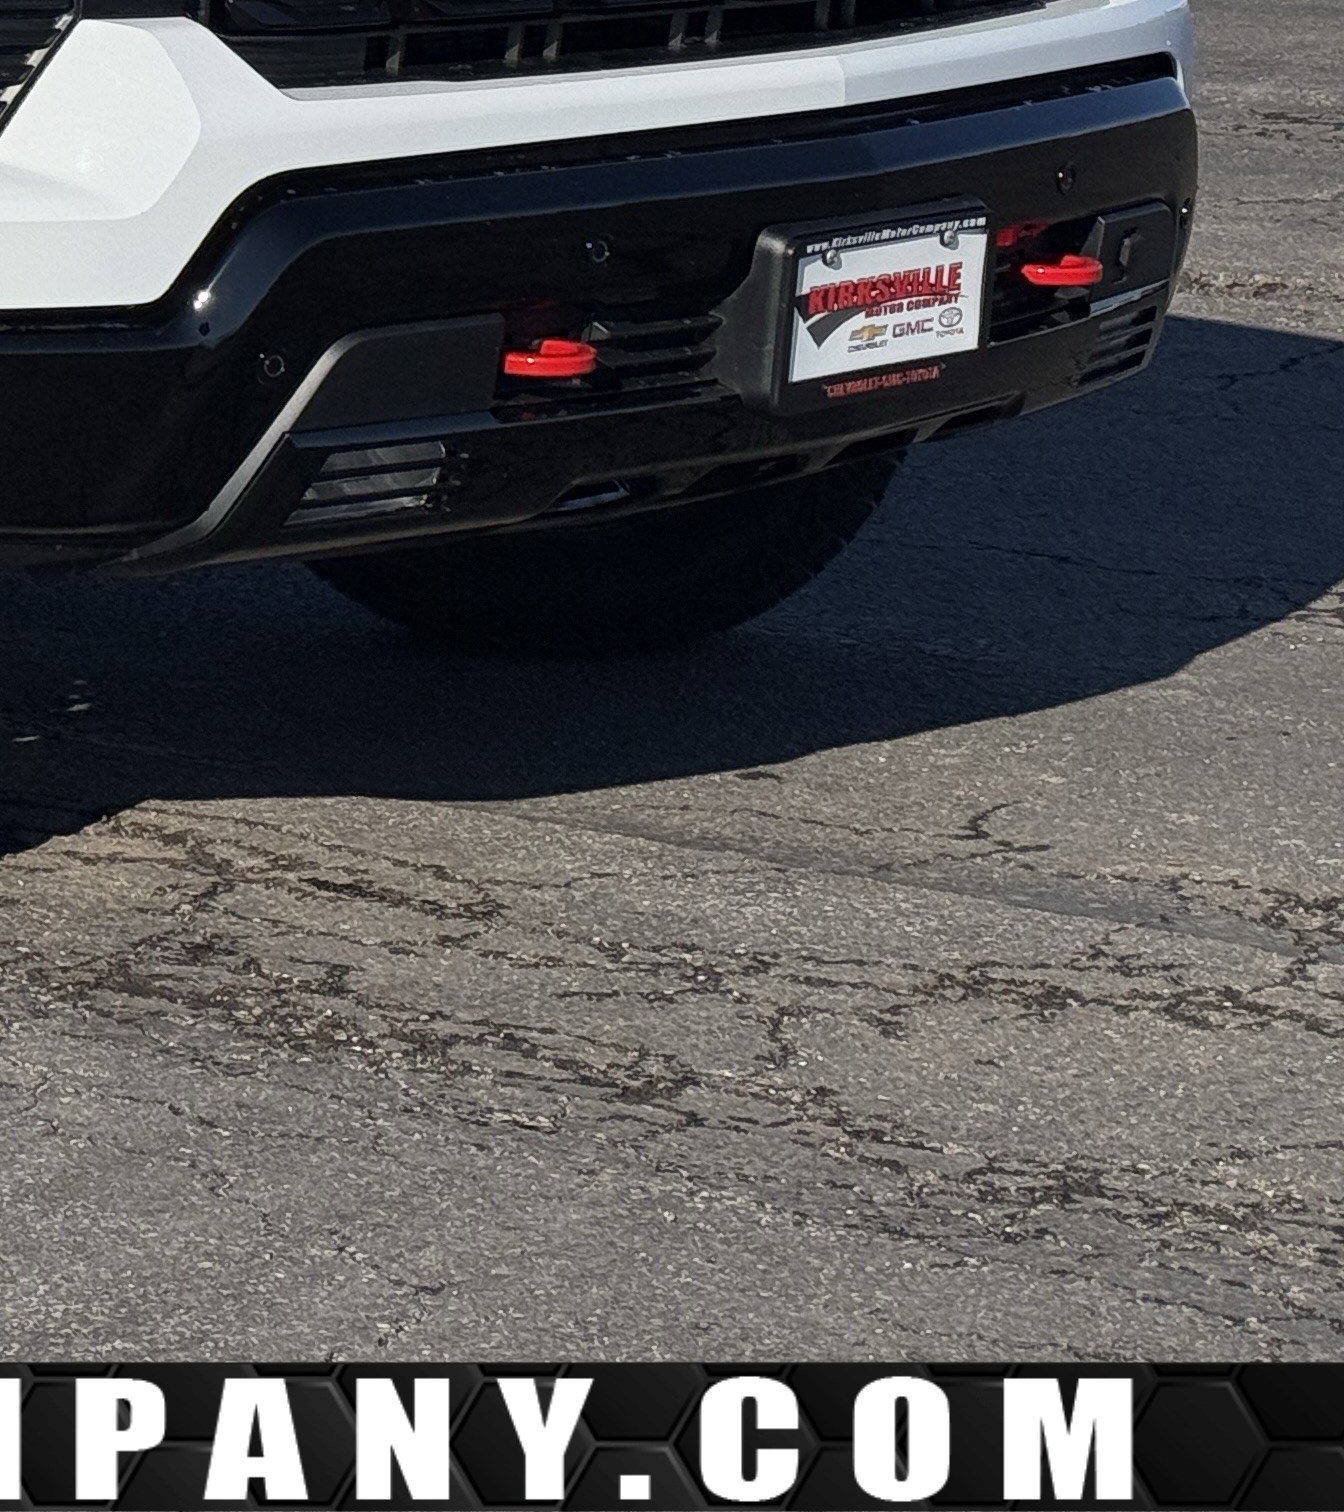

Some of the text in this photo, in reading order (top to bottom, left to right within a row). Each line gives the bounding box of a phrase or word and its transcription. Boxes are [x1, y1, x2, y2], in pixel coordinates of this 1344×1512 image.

[806, 261, 964, 315] KIRKSVILLE
[864, 292, 960, 319] MOTOR COMPANY
[892, 317, 935, 339] GMC
[935, 328, 965, 339] TOYOTA
[847, 339, 889, 353] CHEVROLET
